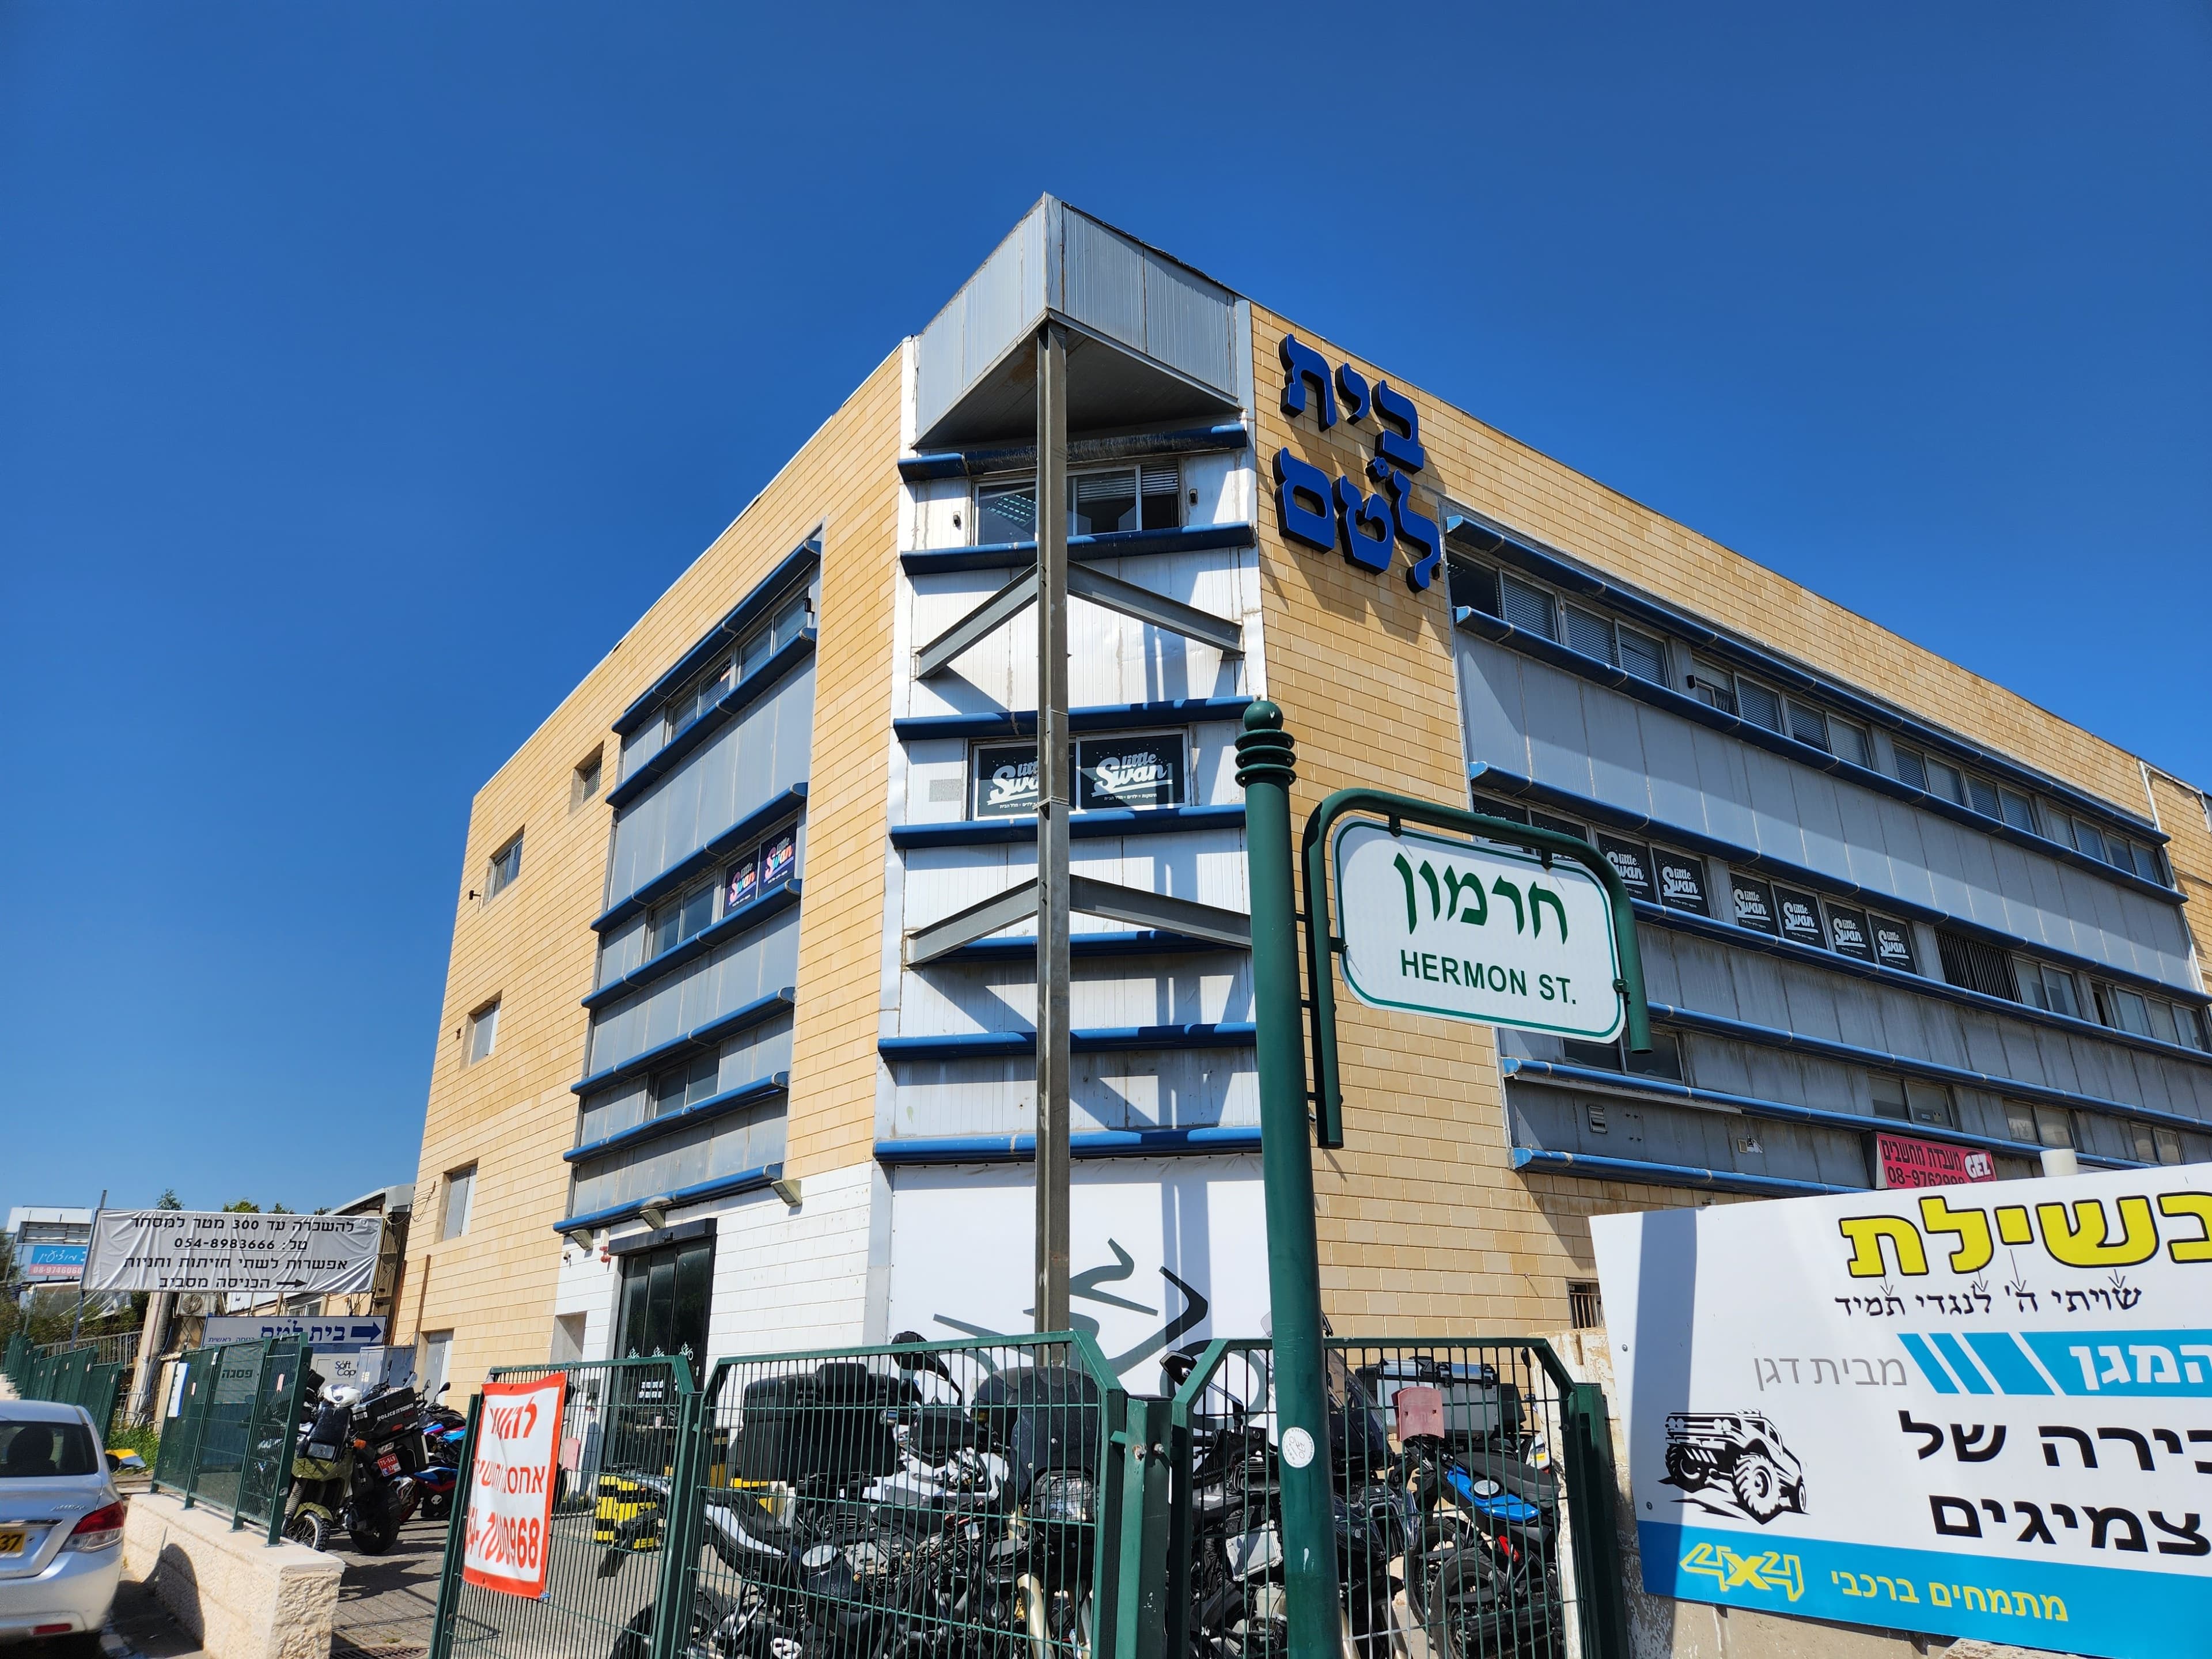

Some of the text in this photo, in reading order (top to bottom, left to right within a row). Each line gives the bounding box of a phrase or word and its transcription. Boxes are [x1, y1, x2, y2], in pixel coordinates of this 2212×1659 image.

[1279, 334, 1425, 474] בית
[1017, 761, 1038, 777] lit
[1122, 752, 1157, 769] little
[990, 765, 1038, 796] Swa
[1094, 757, 1167, 793] Swan
[765, 844, 793, 880] Swan
[1618, 853, 1637, 866] little
[1662, 866, 1698, 893] Swan
[1673, 868, 1692, 880] little
[729, 871, 756, 903] Swan
[1393, 852, 1568, 945] חרמון
[1744, 891, 1760, 902] little
[1734, 889, 1767, 915] Swan
[1793, 903, 1808, 914] little
[1783, 902, 1815, 927] Swan
[1842, 919, 1856, 929] little
[1834, 918, 1862, 942] Swan
[1878, 930, 1906, 953] Swan
[1400, 949, 1577, 1005] HERMON ST.
[1880, 1139, 1925, 1166] מחשבים
[131, 1216, 354, 1232] להשכרה עד 300 מטר למסחר
[175, 1238, 308, 1250] טל: 054-8983666
[123, 1257, 347, 1270] אפשרות לשתי חזיתות וחניות
[159, 1277, 270, 1289] הכניסה מסביב
[1835, 1293, 1906, 1317] תמיד
[1916, 1283, 1992, 1316] לנגדי
[2051, 1286, 2143, 1314] שויתי
[309, 1325, 346, 1341] בית
[222, 1369, 253, 1378] פסגה
[335, 1360, 351, 1369] Soft
[337, 1368, 357, 1378] Cop
[1753, 1357, 1907, 1392] מבית דגן
[2069, 1344, 2212, 1391] המגן
[377, 1410, 396, 1421] POLICE
[1897, 1410, 2006, 1462] של
[1929, 1494, 2212, 1556] צמיגים
[1831, 1570, 1920, 1604] ברכבי
[1929, 1581, 2069, 1622] מתמחים
